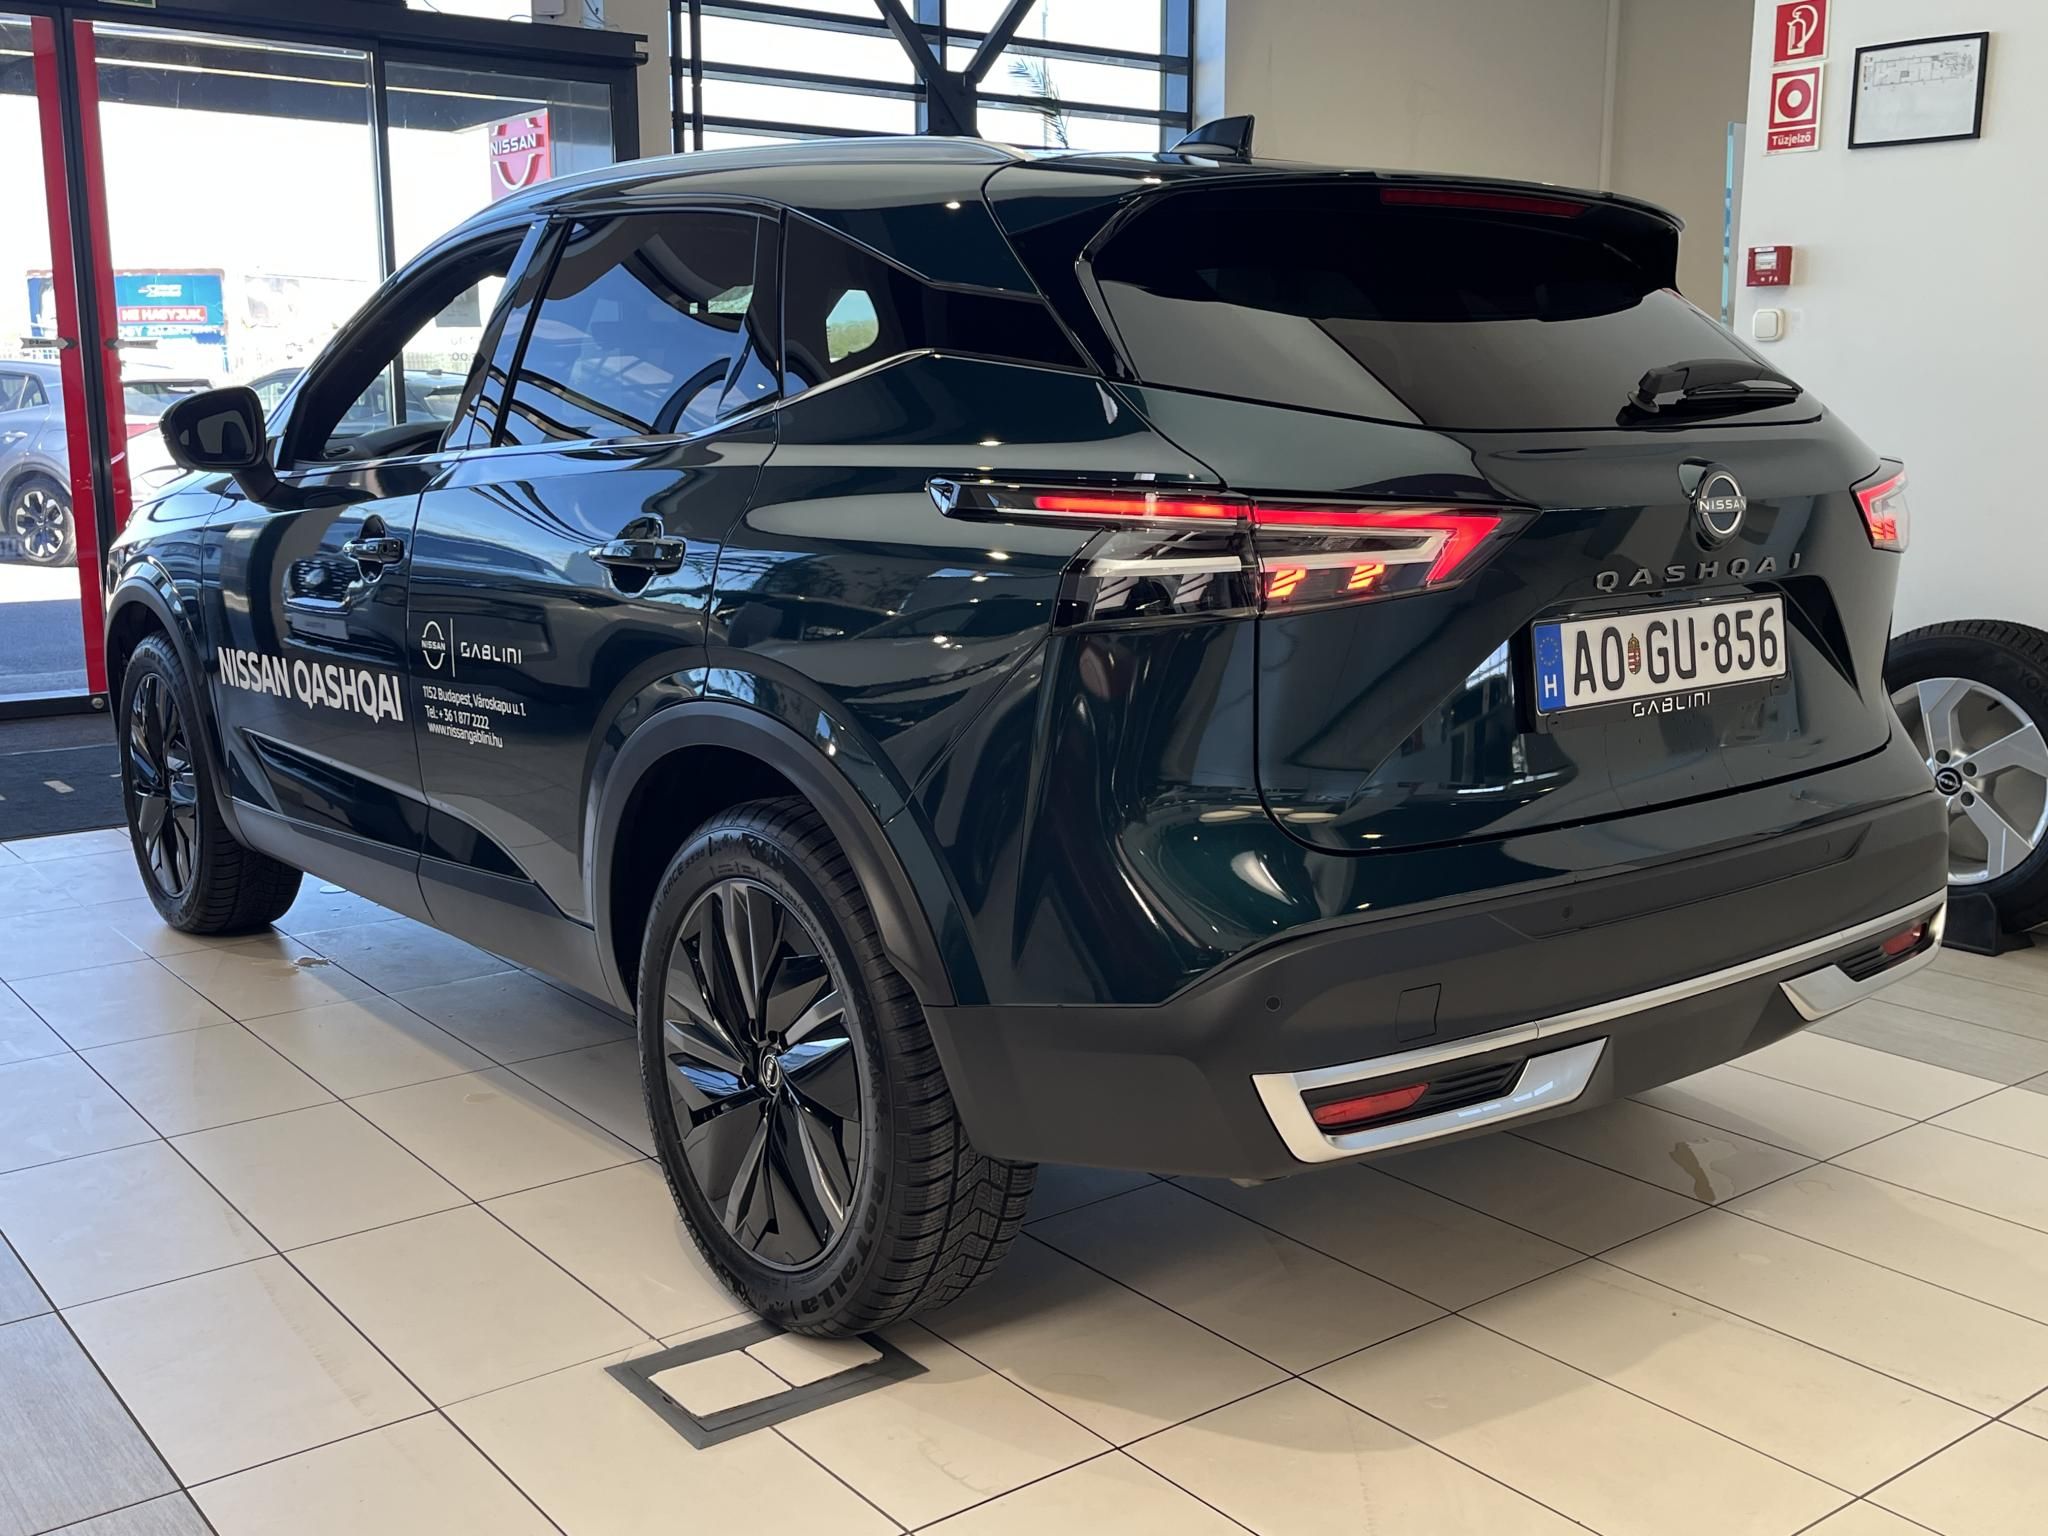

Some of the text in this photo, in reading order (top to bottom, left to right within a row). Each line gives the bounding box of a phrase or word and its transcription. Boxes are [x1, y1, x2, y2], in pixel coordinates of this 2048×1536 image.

[490, 133, 537, 155] NISSAN
[1772, 131, 1811, 146] Tűzjelző
[1699, 497, 1747, 512] NISSAN
[1596, 552, 1801, 593] QASHQAI
[421, 639, 446, 651] NISSAN
[460, 641, 522, 664] GABLINI
[1573, 626, 1625, 696] AO
[217, 646, 292, 699] NISSAN
[293, 659, 404, 724] QASHQAI
[1544, 673, 1558, 699] H
[422, 685, 437, 700] 1152
[437, 688, 473, 708] Budapest,
[472, 693, 512, 716] Városkapu
[1632, 691, 1711, 718] GABLINI
[458, 711, 471, 725] 877
[471, 713, 490, 730] 2222
[427, 722, 503, 748] www.nissangablini.hu
